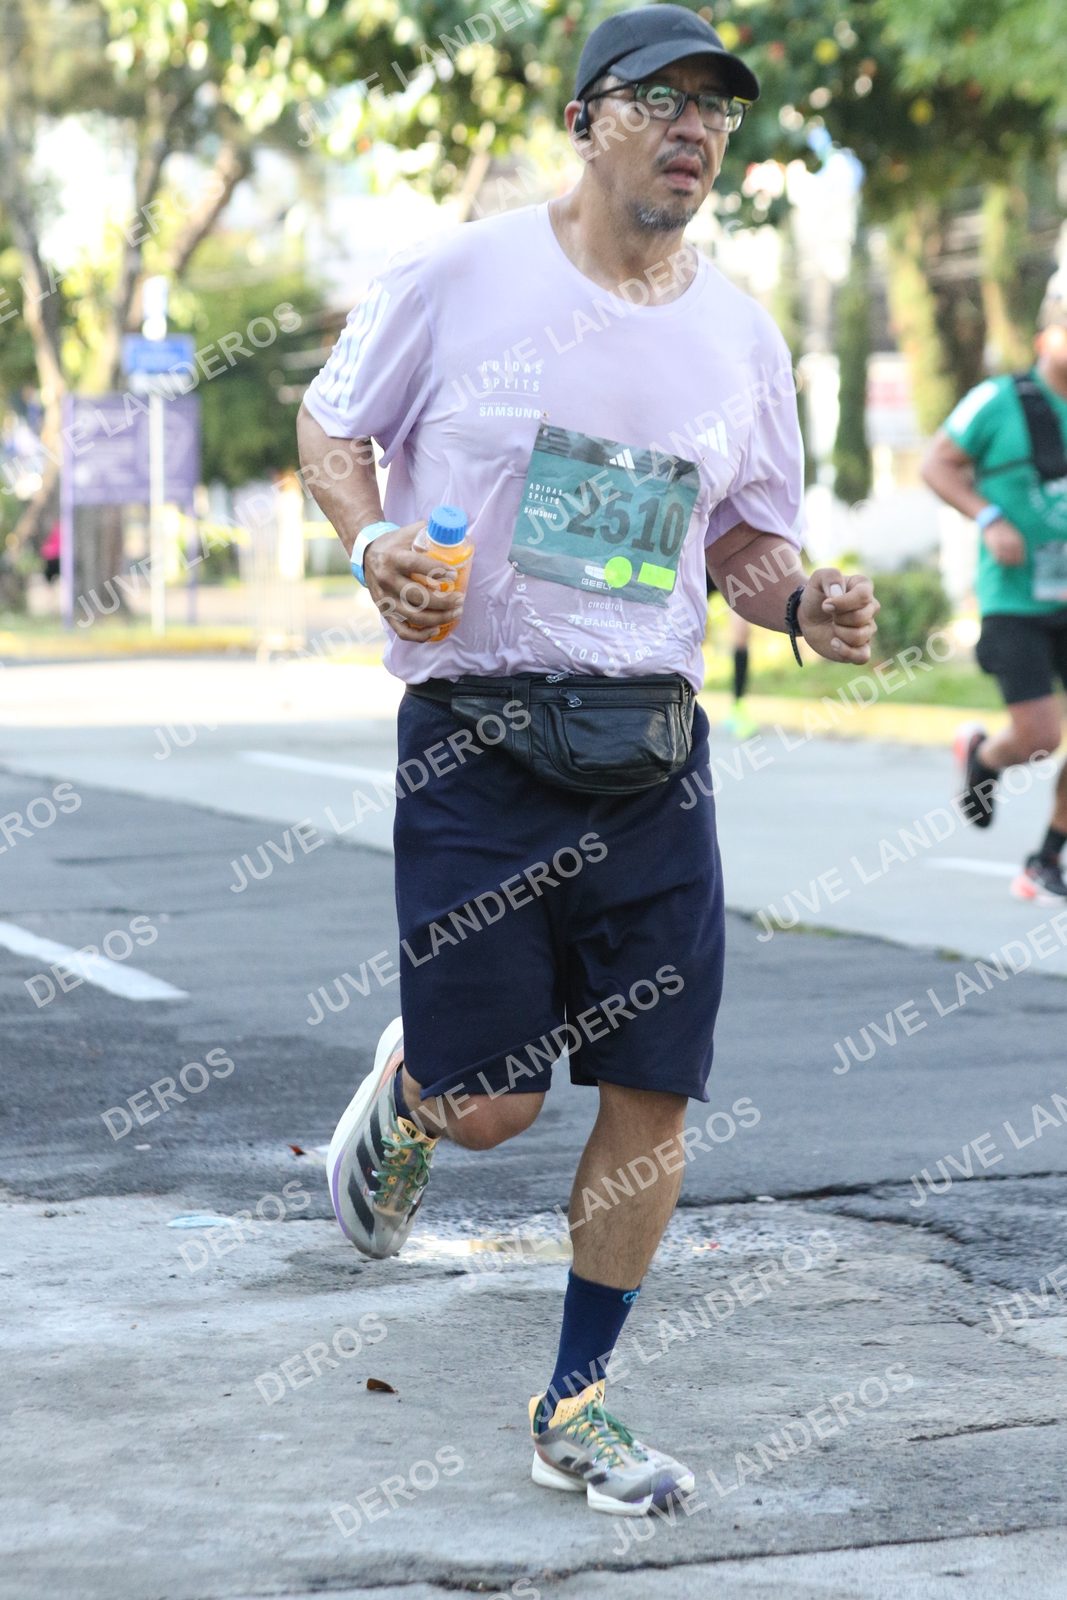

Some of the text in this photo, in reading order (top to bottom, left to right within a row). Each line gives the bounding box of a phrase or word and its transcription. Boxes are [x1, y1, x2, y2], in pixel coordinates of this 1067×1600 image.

[481, 360, 542, 376] ADIDAS
[482, 378, 541, 393] SPLITS
[479, 406, 541, 420] SAMSUNG
[529, 482, 563, 496] ADIDAS
[523, 506, 558, 520] SAMSUNG
[566, 482, 685, 557] 2510
